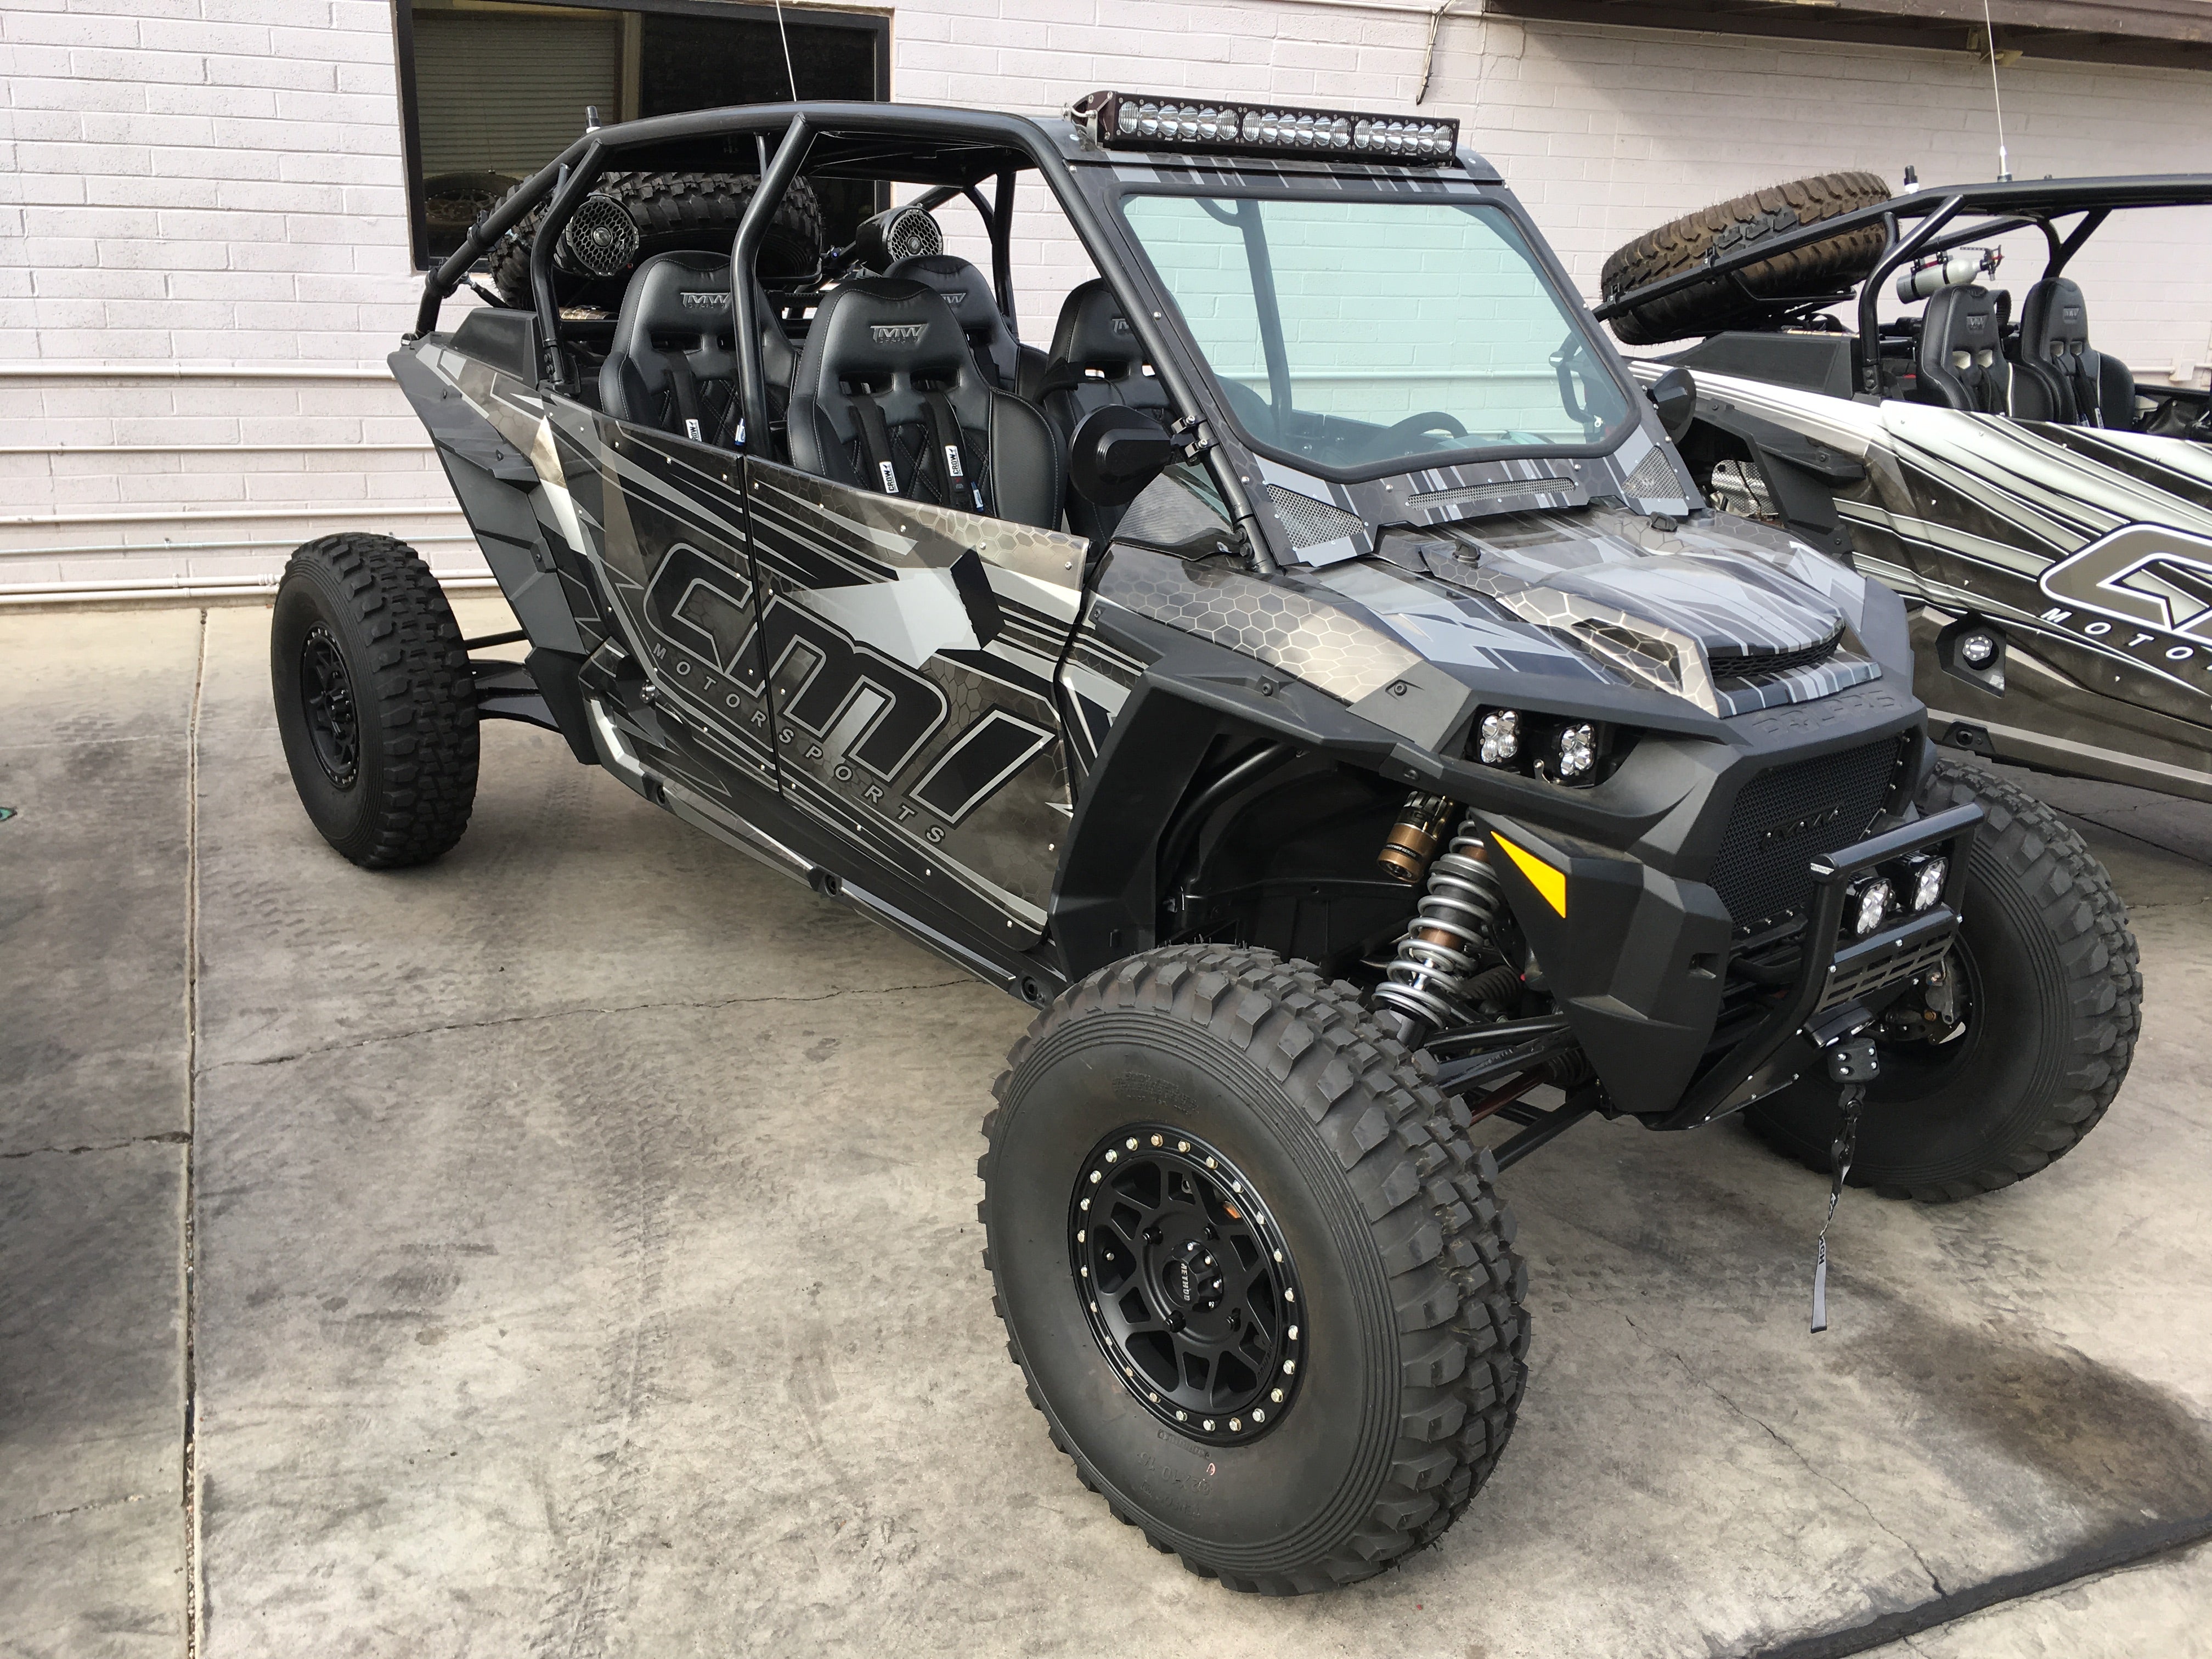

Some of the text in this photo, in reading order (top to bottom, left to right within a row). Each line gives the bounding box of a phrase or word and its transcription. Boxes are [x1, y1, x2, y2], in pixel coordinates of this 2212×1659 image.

[680, 292, 731, 307] TMW
[870, 323, 928, 343] TMW
[1111, 318, 1130, 334] TM
[949, 453, 960, 475] CROW
[883, 467, 895, 492] CROW
[2040, 607, 2212, 671] MOTO
[652, 643, 946, 843] MOTORSPORTS
